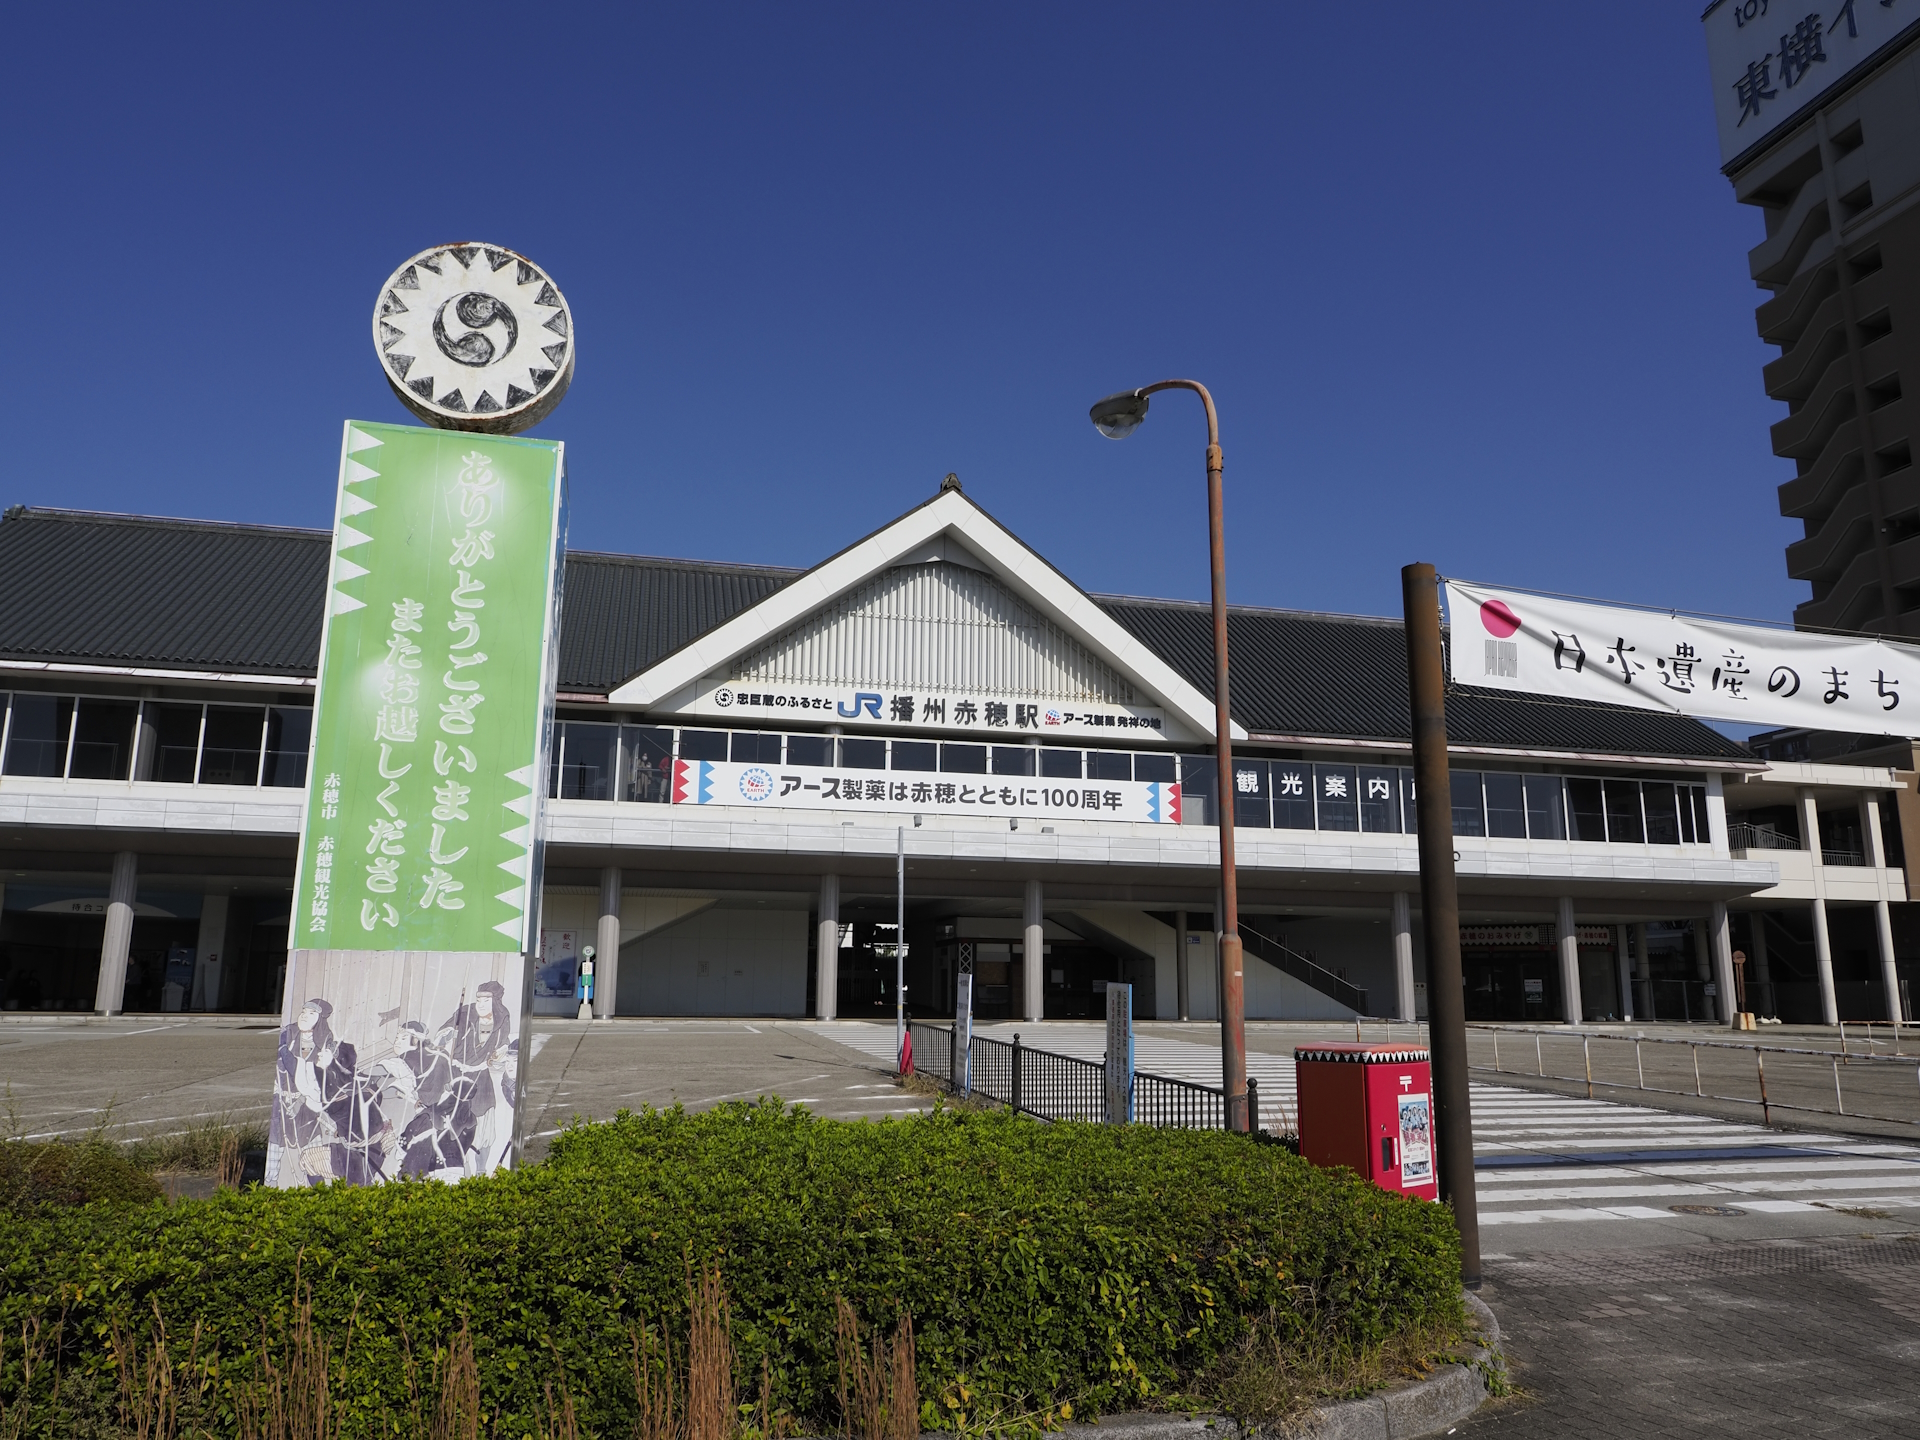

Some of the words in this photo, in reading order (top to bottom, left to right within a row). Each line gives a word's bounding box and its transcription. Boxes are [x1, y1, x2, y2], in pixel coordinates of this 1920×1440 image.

[1732, 0, 1894, 127] 東横イ
[419, 451, 500, 910] ありがとうございました
[1550, 629, 1901, 711] 日本遺産のまち
[736, 692, 833, 710] 忠臣蔵のふるさと
[837, 692, 883, 719] JR
[889, 694, 1039, 730] 播州赤穂駅
[360, 597, 425, 932] またお越しください
[1236, 768, 1416, 801] 観光案内
[321, 772, 341, 820] 赤穂市
[780, 774, 1123, 811] アース製薬は赤穂とともに100周年
[309, 836, 335, 933] 赤穂観光協会
